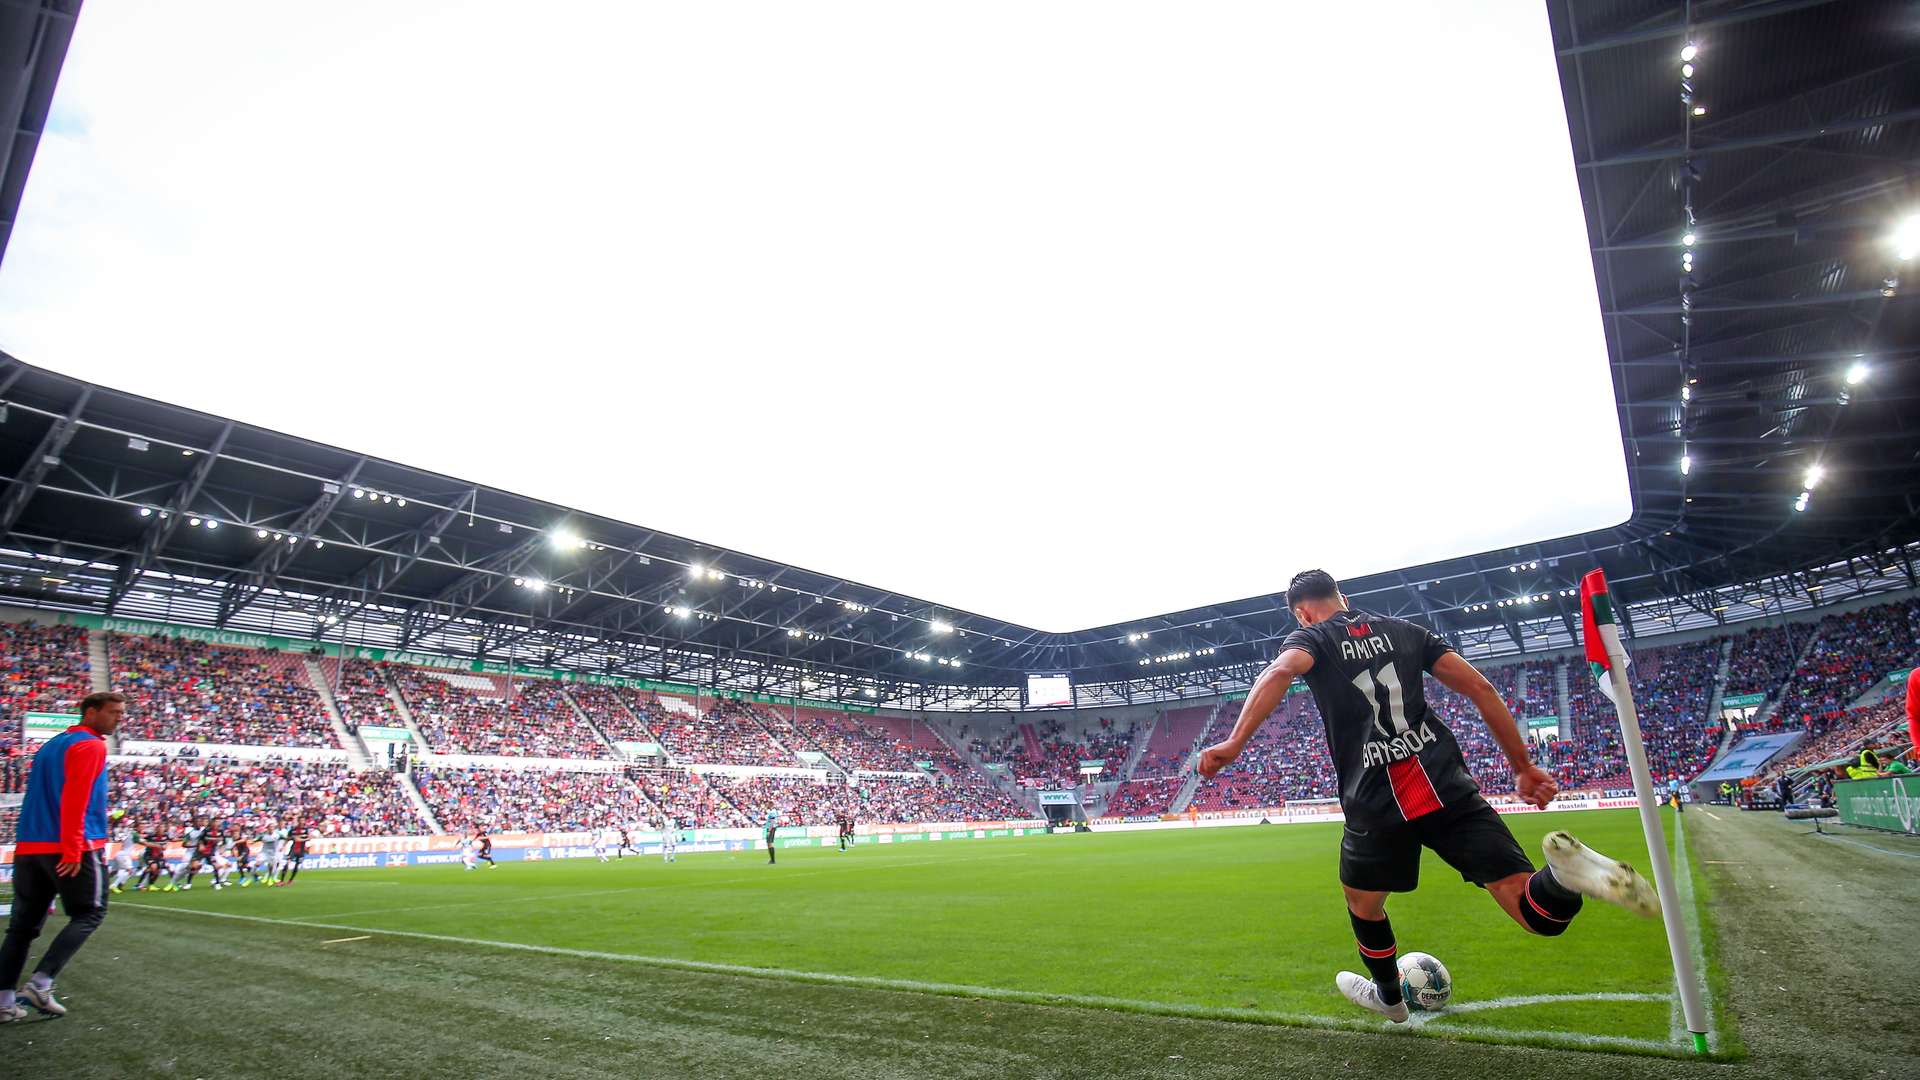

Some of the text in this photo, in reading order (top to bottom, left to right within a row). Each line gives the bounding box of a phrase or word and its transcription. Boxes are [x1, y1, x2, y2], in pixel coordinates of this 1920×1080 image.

[102, 618, 174, 638] DEHNER
[179, 627, 268, 647] RECYCLING
[1341, 633, 1394, 660] AMIRI
[382, 650, 474, 671] KASTNER
[1352, 661, 1410, 737] 11
